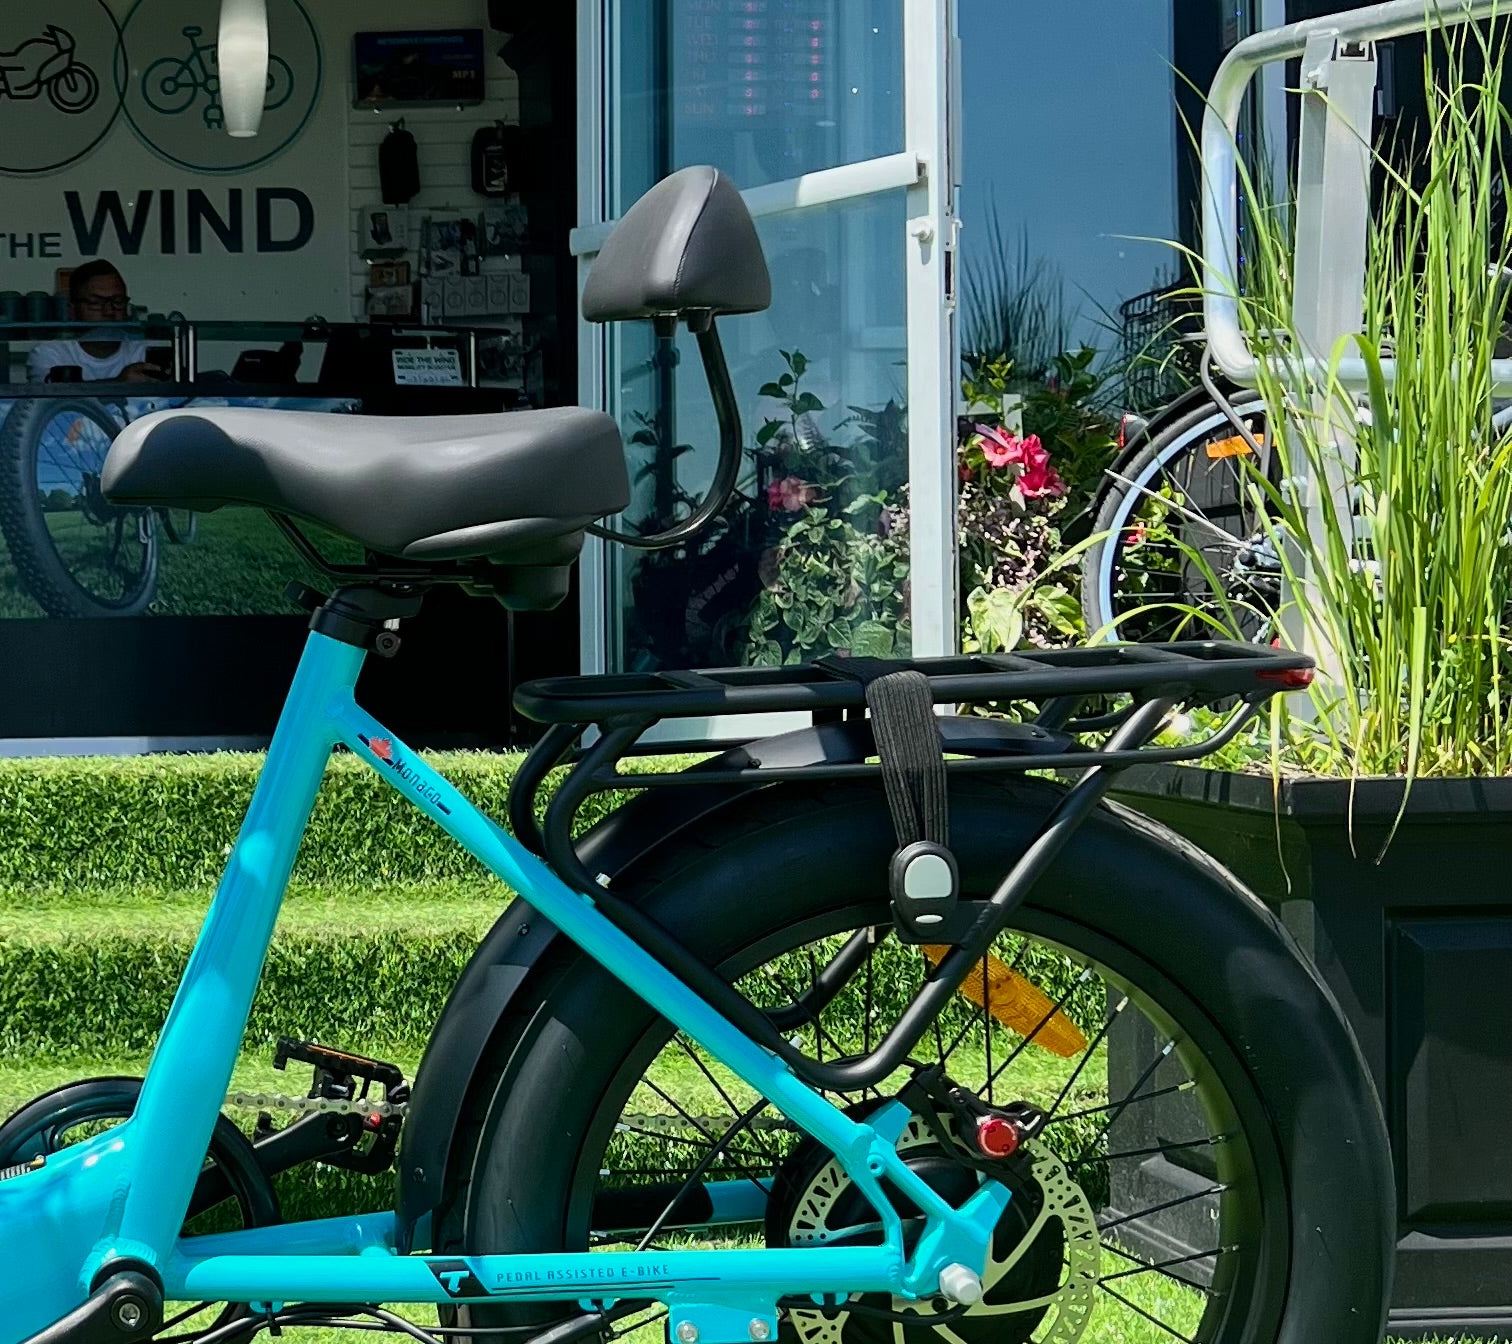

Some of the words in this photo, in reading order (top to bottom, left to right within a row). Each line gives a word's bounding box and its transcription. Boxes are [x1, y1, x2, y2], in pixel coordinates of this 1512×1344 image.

[65, 186, 315, 257] WIND
[497, 1271, 542, 1283] PEDAL
[547, 1267, 615, 1280] ASSISTED
[621, 1264, 670, 1278] E-BIKE
